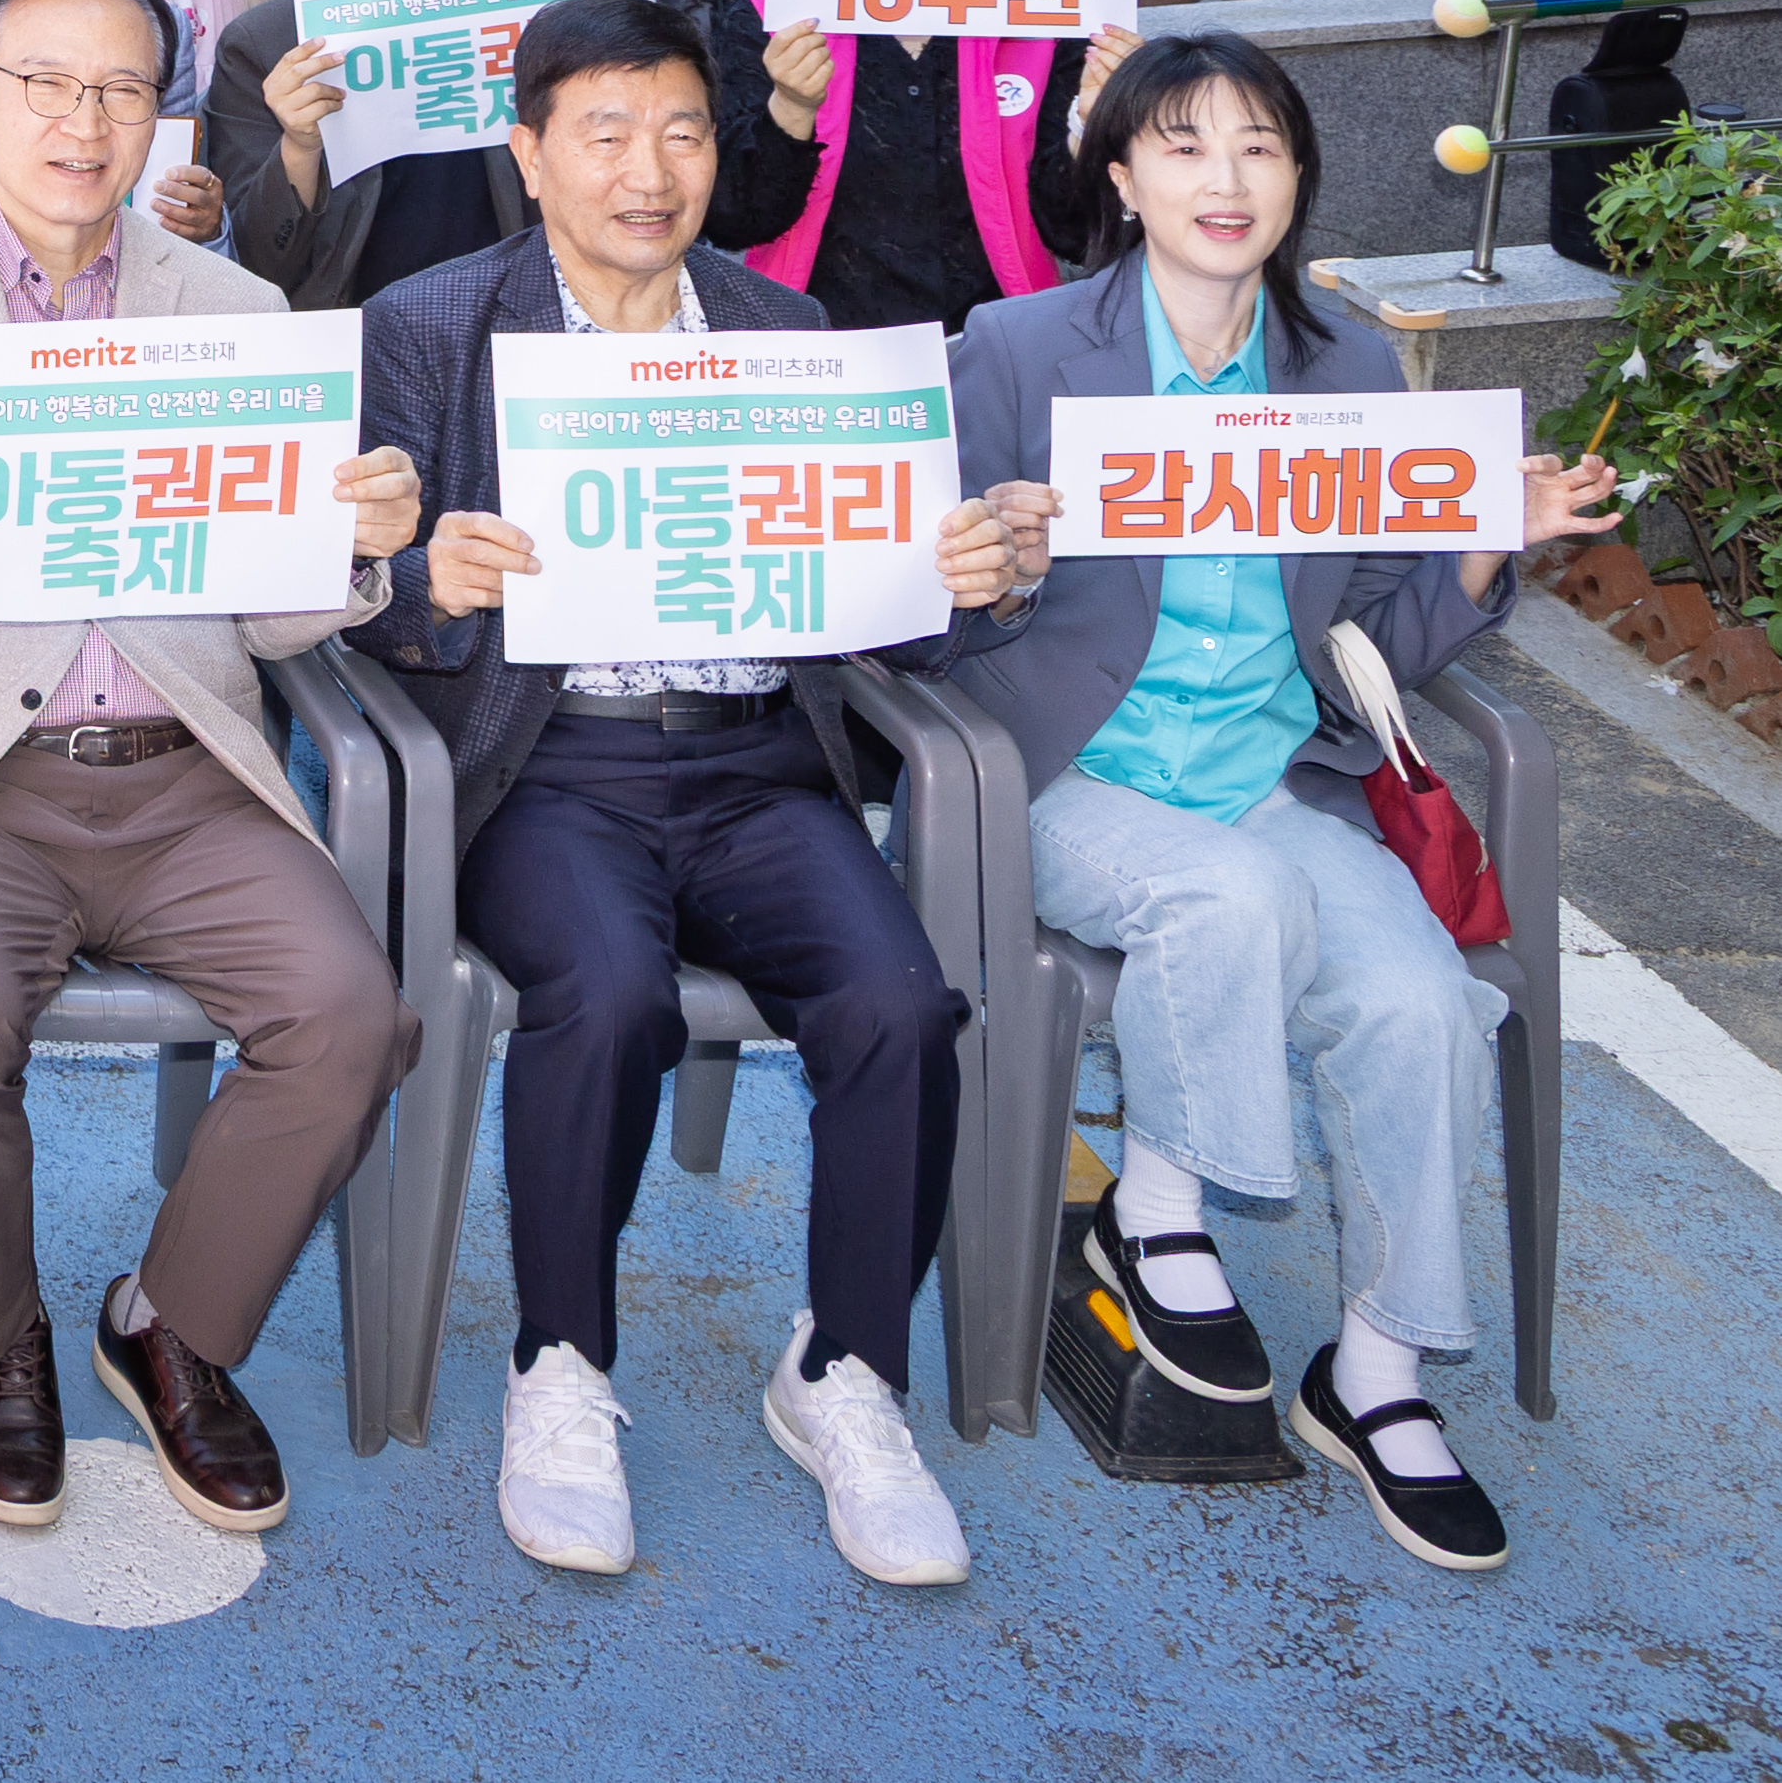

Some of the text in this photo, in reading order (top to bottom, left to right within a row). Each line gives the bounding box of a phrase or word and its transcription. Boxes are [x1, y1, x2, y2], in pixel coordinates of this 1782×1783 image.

[31, 337, 236, 369] meritz 메리츠화재
[630, 350, 843, 382] meritz 메리츠화재
[45, 394, 140, 424] 행복하고
[146, 390, 220, 418] 안전한
[226, 388, 271, 413] 우리
[278, 384, 325, 412] 마을
[538, 400, 928, 437] 어린이가 행복하고 안전한 우리 마을
[1215, 405, 1363, 427] meritz 메리츠화재
[564, 460, 911, 550] 아동권리
[1099, 447, 1477, 539] 감사해요
[40, 521, 208, 597] 축제
[653, 550, 825, 635] 축제
